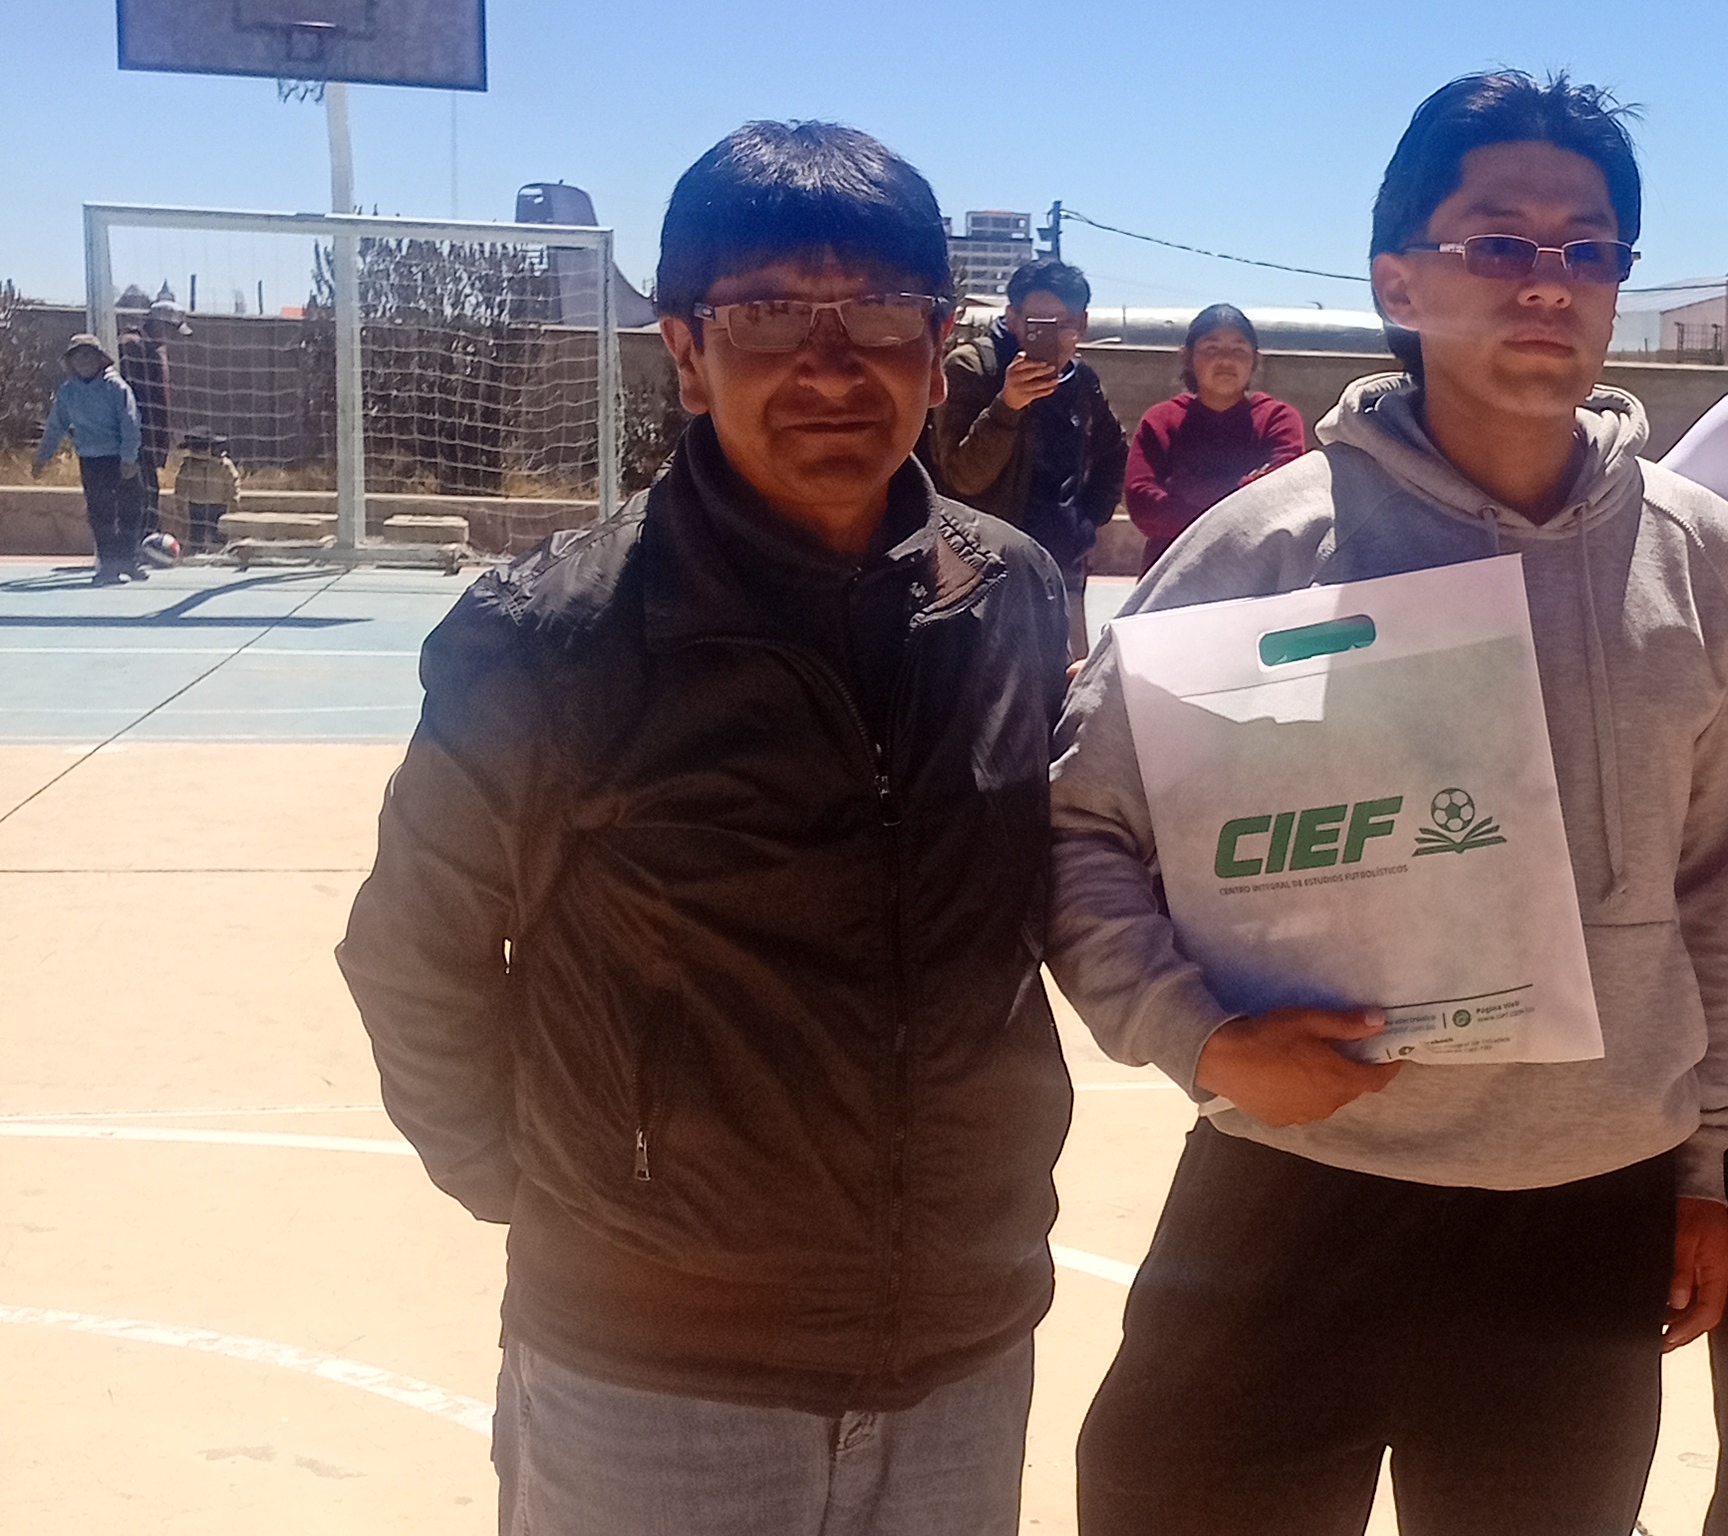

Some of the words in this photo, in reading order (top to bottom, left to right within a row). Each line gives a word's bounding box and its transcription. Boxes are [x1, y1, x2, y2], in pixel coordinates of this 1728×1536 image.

[1214, 796, 1404, 878] CIEF
[1219, 886, 1251, 896] CENTRO
[1252, 881, 1291, 892] INTEGRAL
[1292, 879, 1302, 888] DE
[1304, 875, 1344, 887] ESTUDIOS
[1345, 865, 1409, 881] FUTBOLÍSTICOS
